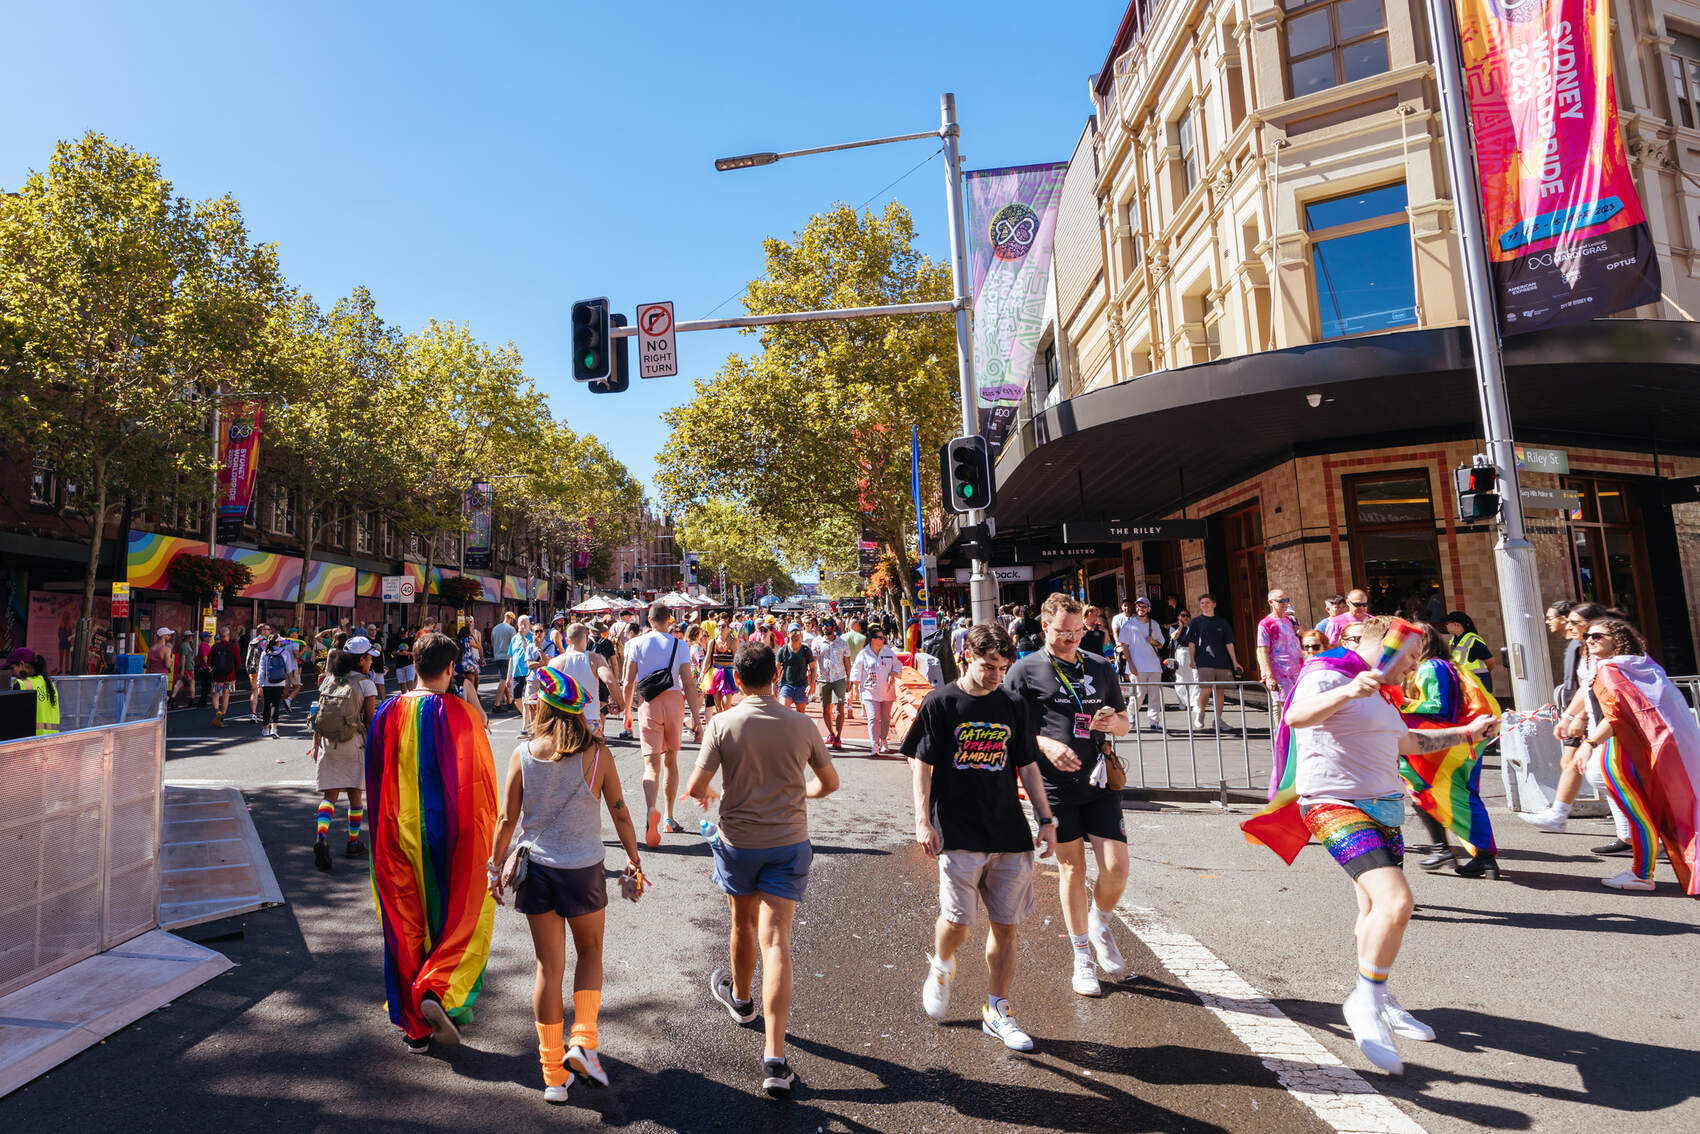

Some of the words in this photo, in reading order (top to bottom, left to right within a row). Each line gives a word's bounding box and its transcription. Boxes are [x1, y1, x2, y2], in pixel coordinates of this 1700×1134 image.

[1507, 43, 1532, 104] 2023
[1550, 20, 1584, 119] SYDNEY
[1532, 29, 1565, 198] WORLDPRIDE
[1582, 244, 1608, 256] GRAS
[1606, 257, 1636, 270] OPTUS
[647, 340, 667, 352] NO
[644, 353, 672, 363] RIGHT
[646, 364, 672, 373] TURN
[239, 449, 247, 480] SYDNEY
[1526, 451, 1548, 467] Riley
[1549, 453, 1560, 465] St
[959, 729, 1007, 741] GATHER
[963, 740, 1003, 752] DREAM
